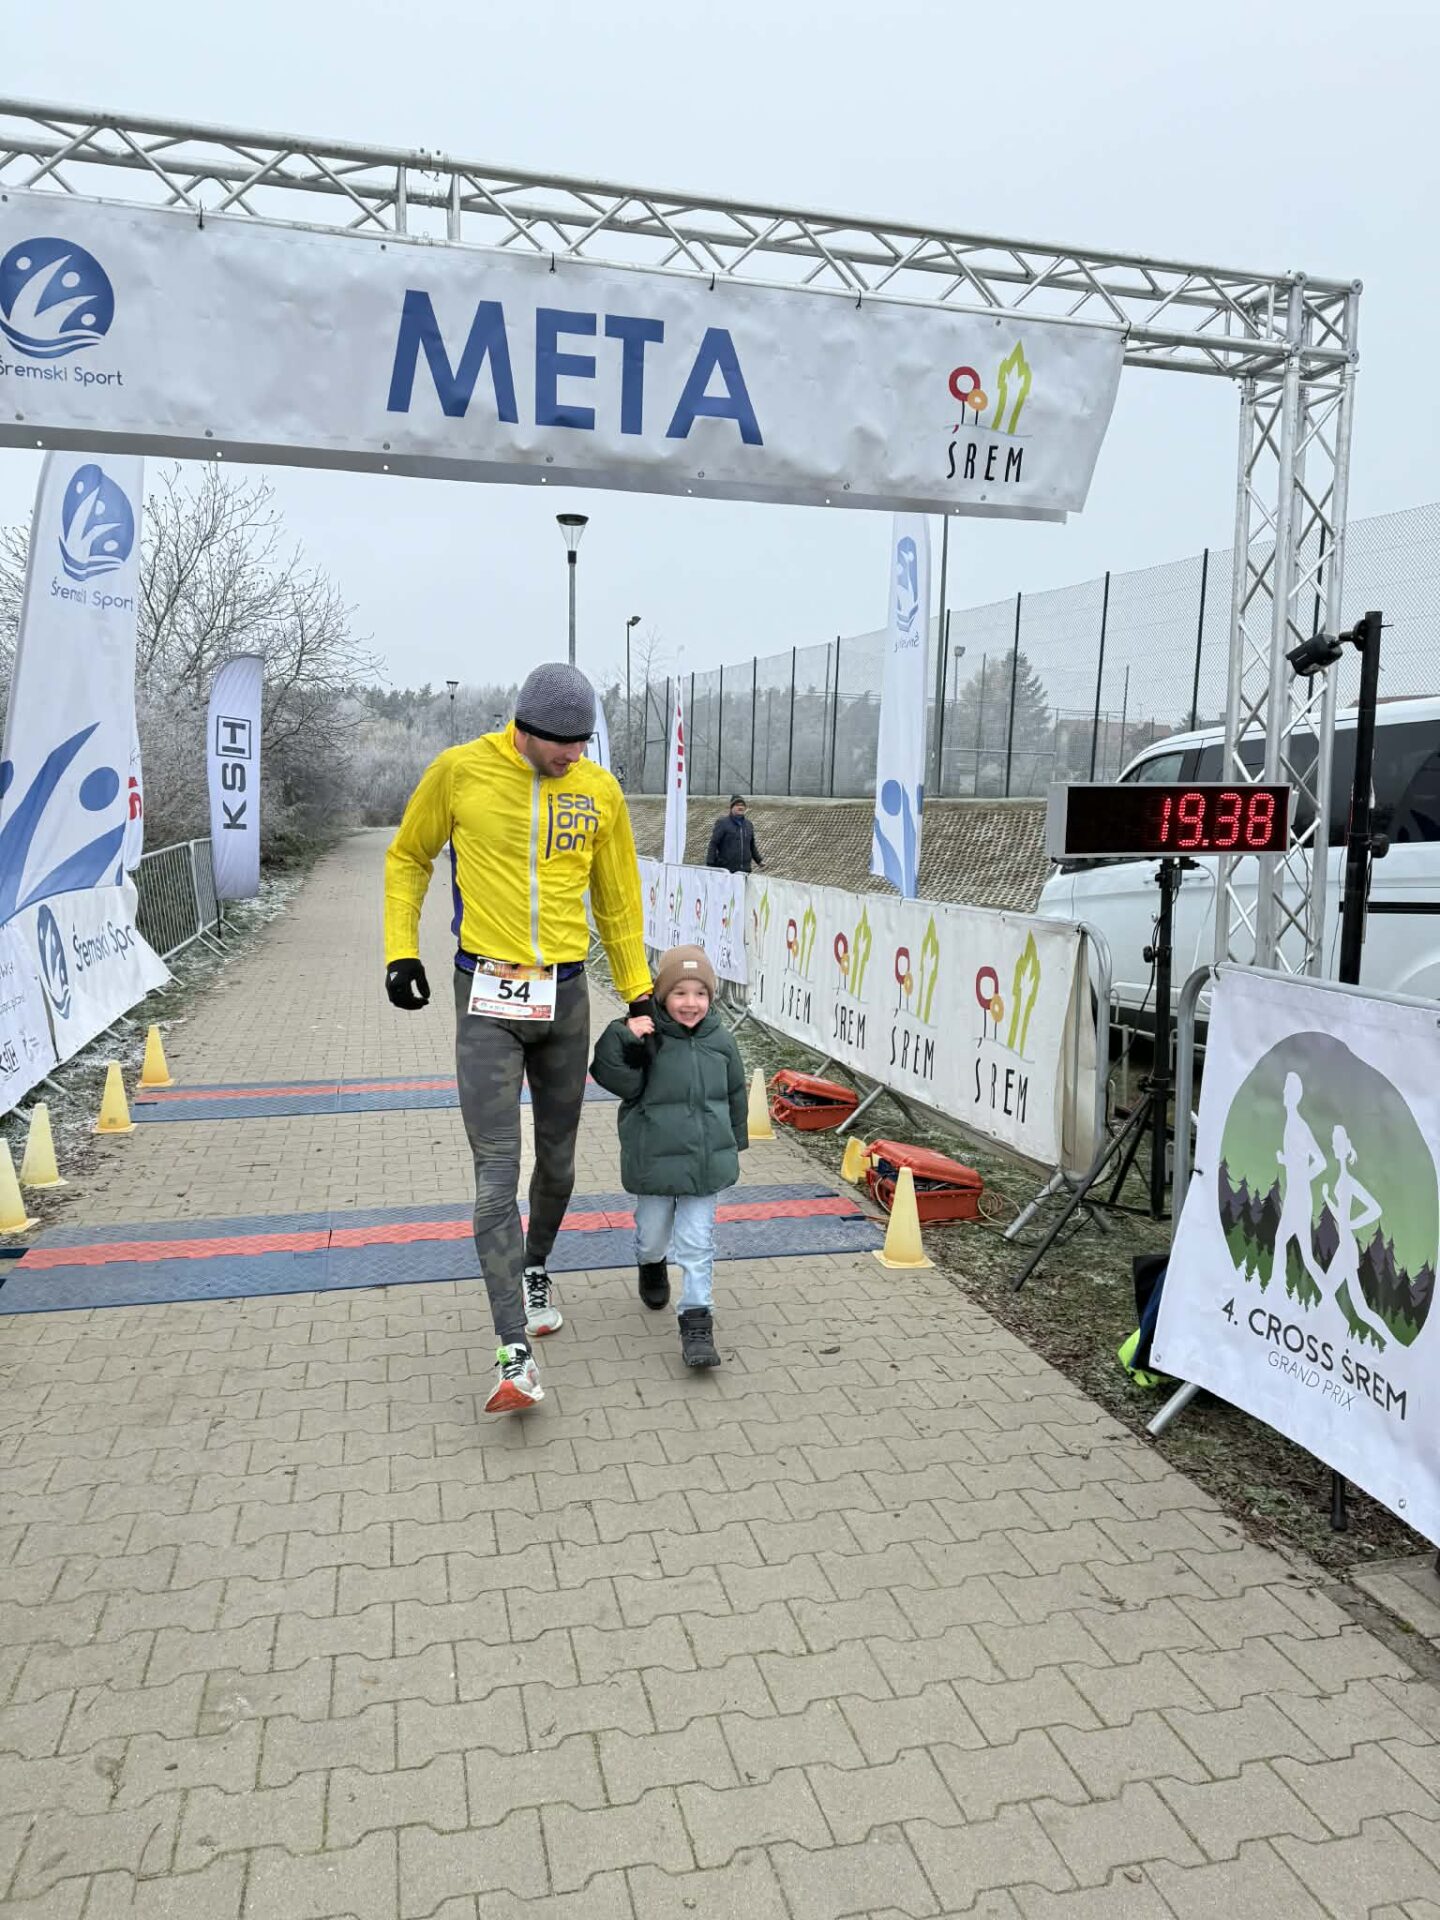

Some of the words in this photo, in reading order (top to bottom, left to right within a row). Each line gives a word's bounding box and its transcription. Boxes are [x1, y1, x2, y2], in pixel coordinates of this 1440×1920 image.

[74, 366, 124, 387] Sport
[387, 289, 764, 446] META
[946, 423, 1025, 483] ŚREM
[221, 720, 249, 831] KSH
[556, 832, 586, 852] on
[1160, 792, 1275, 847] 19.38
[497, 979, 531, 1003] 54
[833, 986, 866, 1051] ŚREM
[890, 1007, 935, 1081] ŚREM
[974, 1036, 1029, 1124] ŚREM
[1221, 1296, 1239, 1326] 4.
[1248, 1307, 1334, 1372] CROSS
[1341, 1347, 1408, 1421] ŚREM
[1267, 1350, 1320, 1388] GRAND
[1321, 1379, 1357, 1412] PRIX
